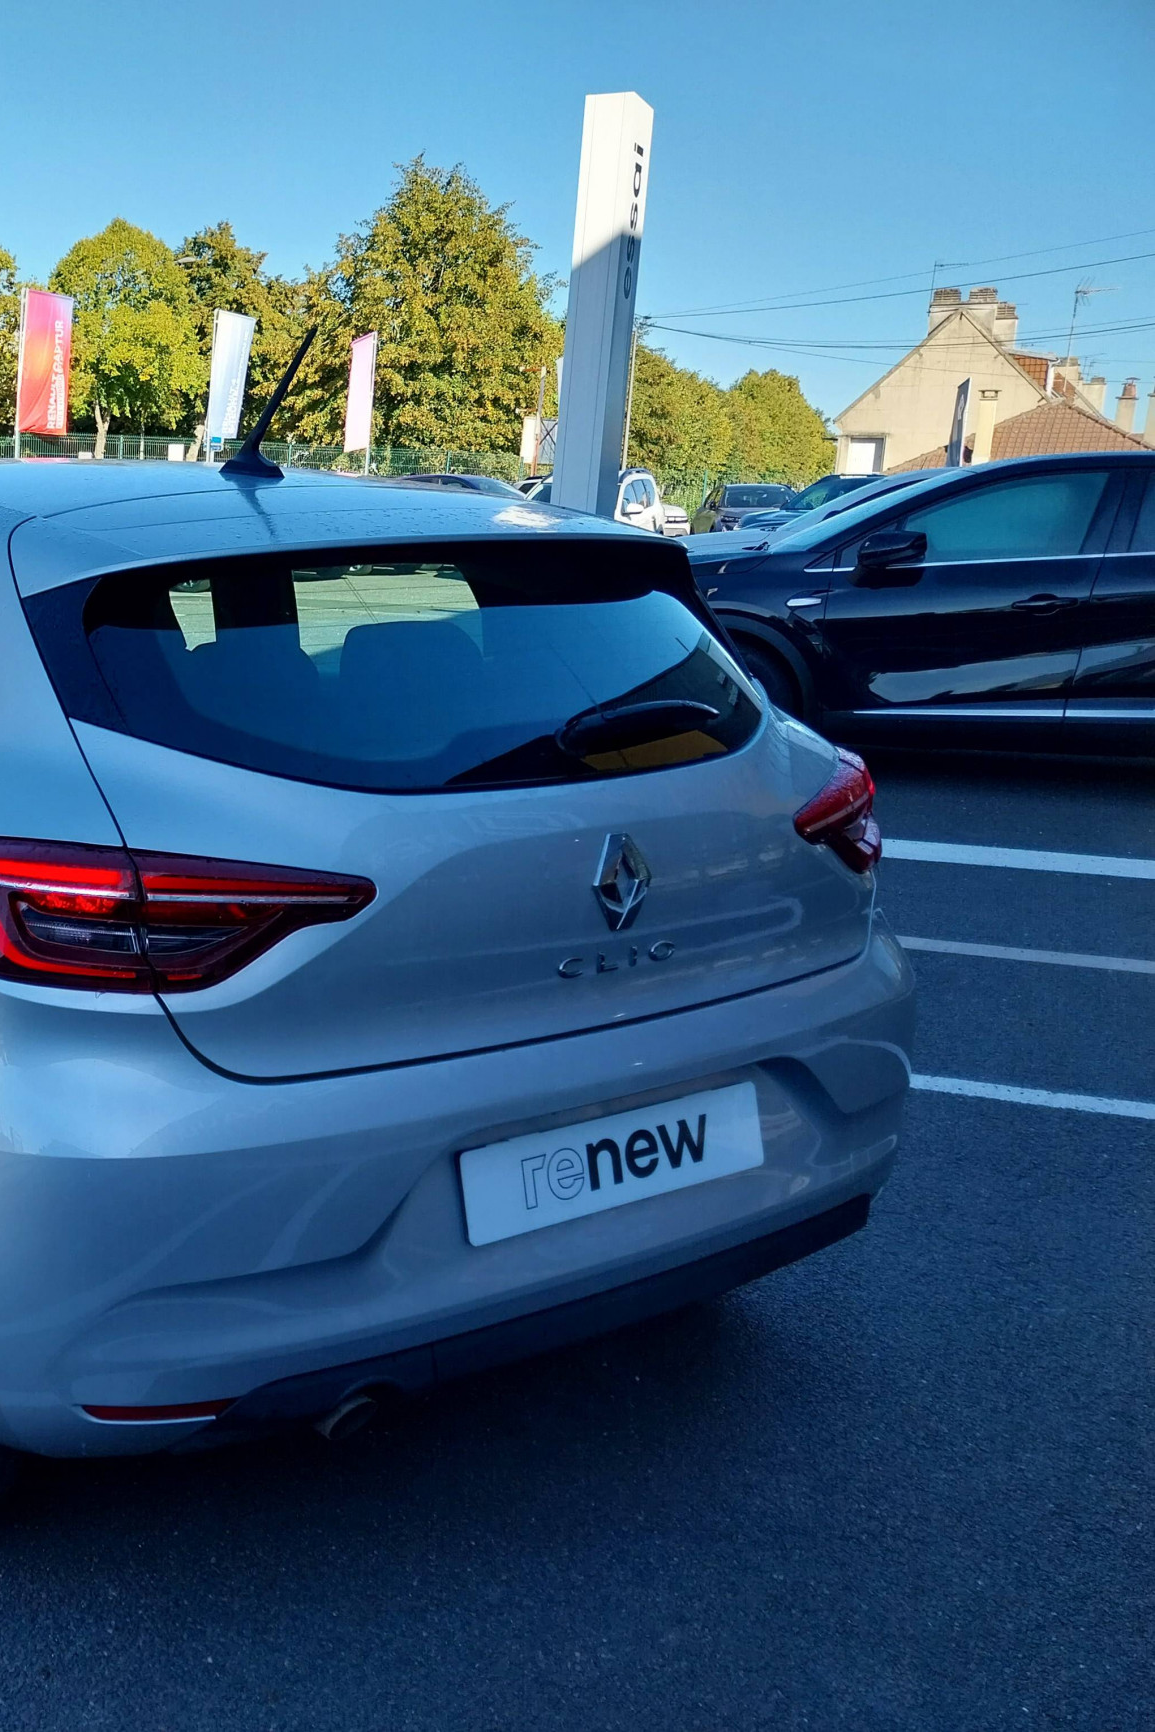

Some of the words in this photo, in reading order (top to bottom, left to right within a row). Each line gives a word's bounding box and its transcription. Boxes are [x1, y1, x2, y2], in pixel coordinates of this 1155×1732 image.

[623, 143, 644, 299] essai
[46, 373, 57, 429] RENAULT
[53, 320, 64, 373] CAPTUR
[557, 940, 675, 979] CLIO
[521, 1113, 707, 1210] renew
